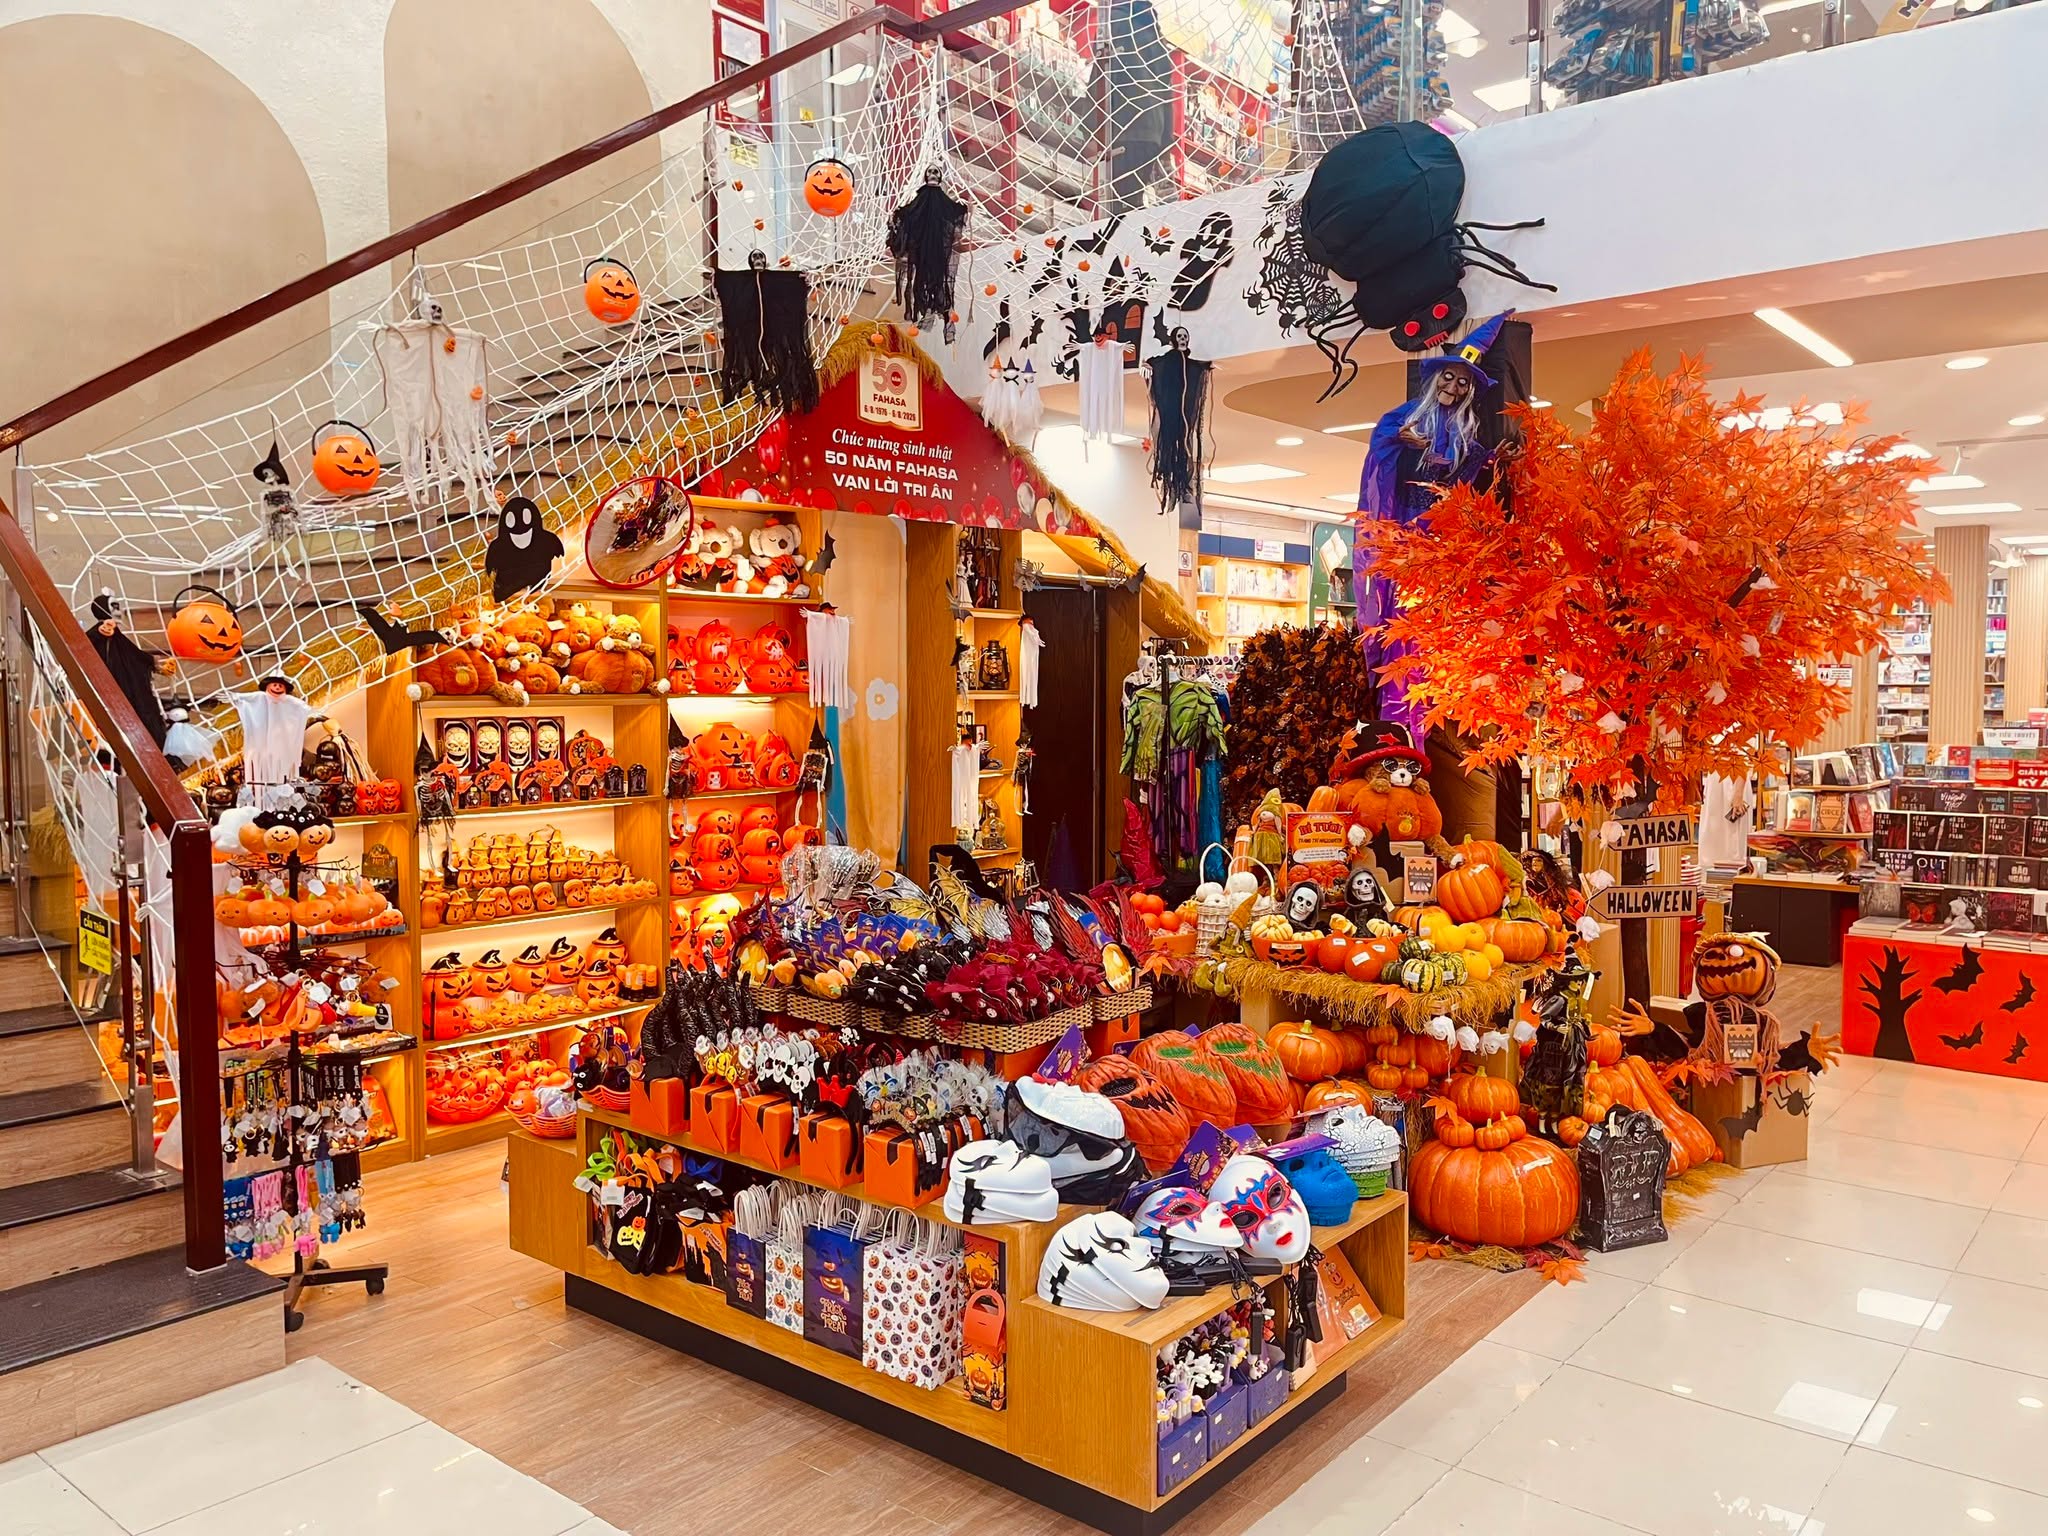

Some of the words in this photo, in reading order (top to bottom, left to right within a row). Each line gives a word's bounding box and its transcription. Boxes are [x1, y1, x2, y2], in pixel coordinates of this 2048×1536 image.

[872, 359, 907, 395] 50
[874, 394, 906, 406] FAHASA
[832, 428, 864, 446] Chúc
[867, 435, 899, 456] mừng
[903, 441, 925, 456] sinh
[929, 445, 952, 463] nhật
[825, 450, 847, 466] 50
[853, 454, 892, 471] NĂM
[896, 461, 958, 480] FAHASA
[833, 473, 870, 490] VẠN
[875, 476, 898, 494] LỜI
[903, 482, 926, 496] TRI
[931, 484, 952, 500] ÂN
[1917, 858, 1947, 870] OUT
[1608, 890, 1692, 914] HALLOWEEN
[820, 1312, 847, 1335] TREAT
